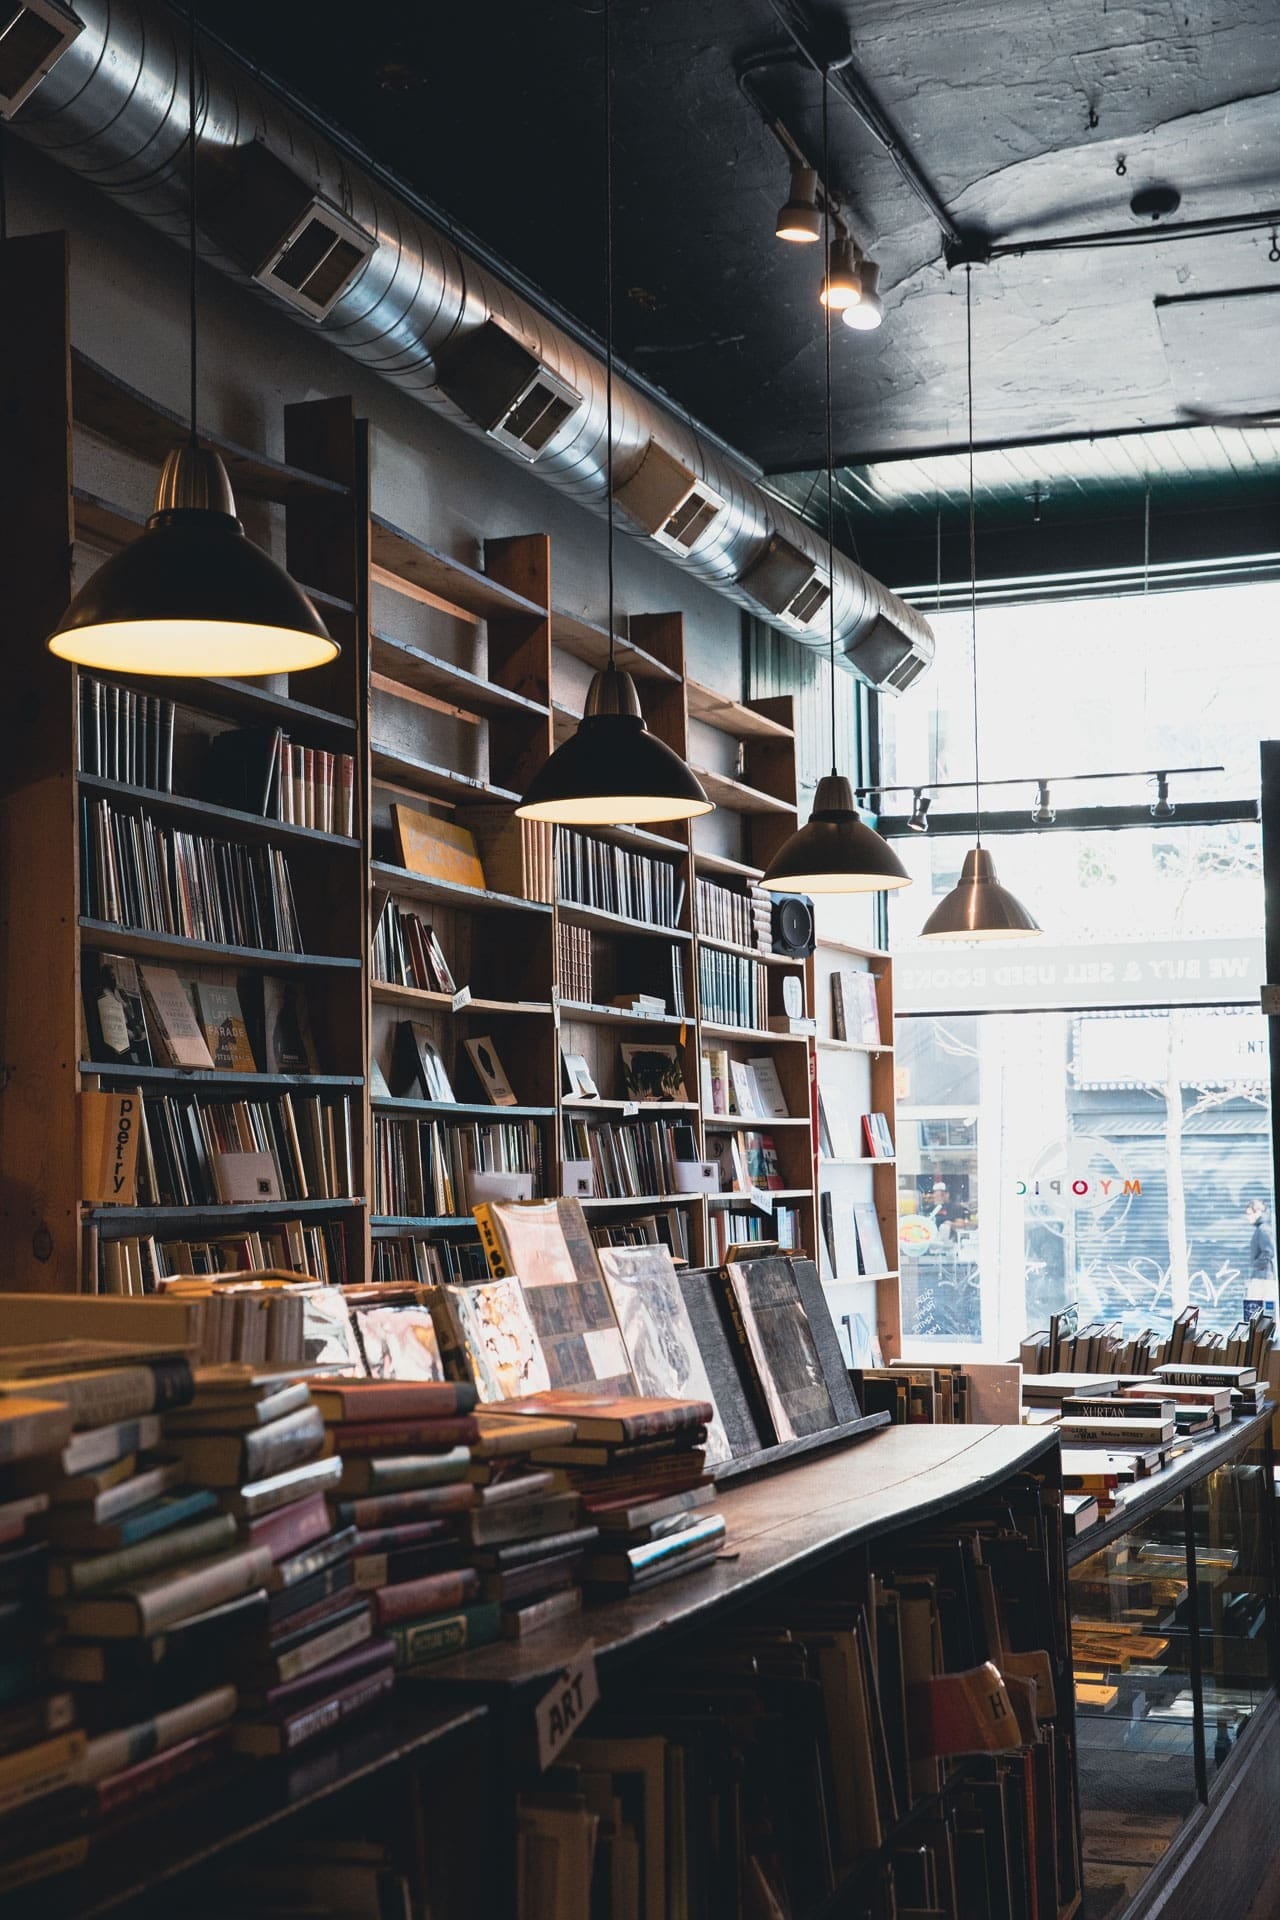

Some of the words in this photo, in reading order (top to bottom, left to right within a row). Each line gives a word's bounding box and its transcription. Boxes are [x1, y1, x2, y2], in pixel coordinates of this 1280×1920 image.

[208, 1026, 244, 1037] PARADE
[113, 1098, 132, 1193] poetry
[703, 1169, 711, 1177] S
[259, 1181, 269, 1192] B
[577, 1180, 587, 1190] R
[549, 1672, 583, 1745] ART
[989, 1692, 1007, 1719] H
